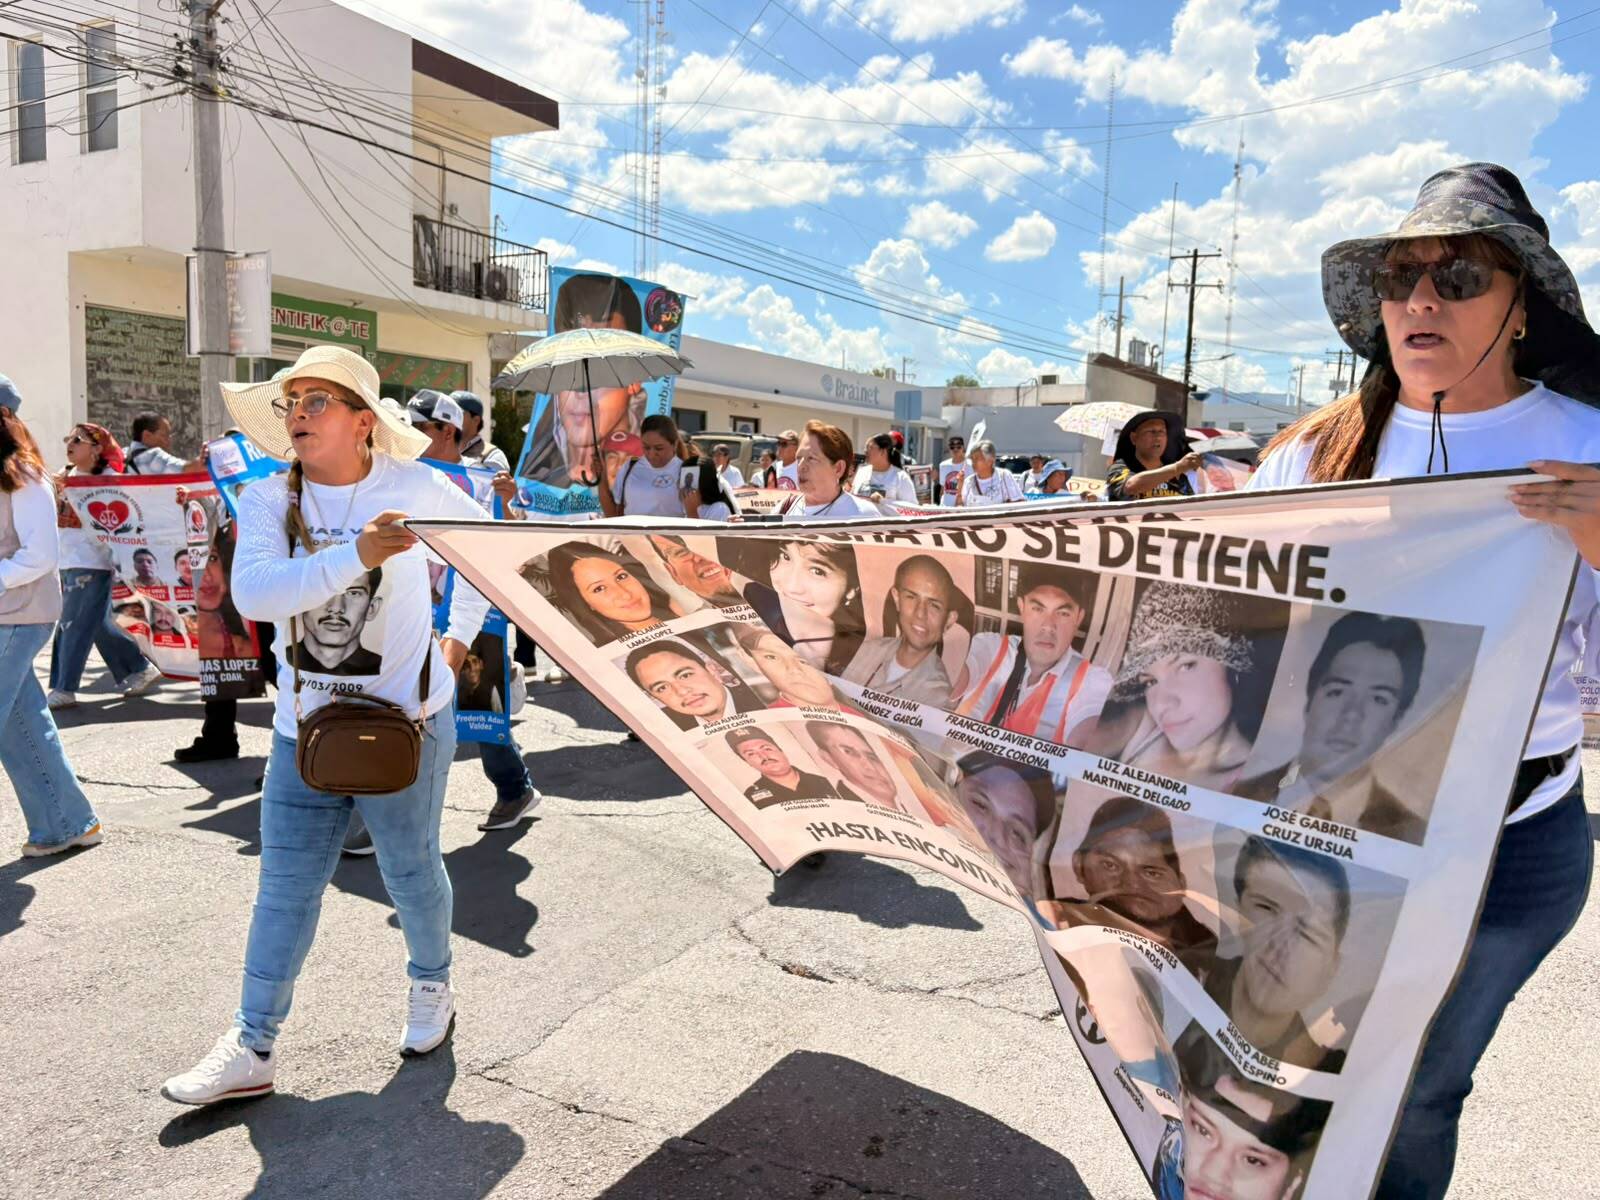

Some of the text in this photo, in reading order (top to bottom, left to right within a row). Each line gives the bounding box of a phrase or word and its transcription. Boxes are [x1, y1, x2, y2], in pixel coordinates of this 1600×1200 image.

[835, 377, 880, 405] Brainet
[1022, 525, 1082, 564] SE
[1098, 523, 1347, 604] DETIENE.
[223, 659, 259, 671] LOPEZ
[861, 688, 900, 708] ROBERTO
[893, 713, 923, 729] GARCÍA
[945, 714, 1000, 739] FRANCISCO
[999, 726, 1037, 750] JAVIER
[1033, 742, 1069, 759] OSIRIS
[946, 728, 1005, 757] HERNANDEZ
[1005, 748, 1051, 770] CORONA
[1082, 769, 1191, 812] MARTINEZ DELGADO
[1097, 758, 1188, 796] LUZ ALEJANDRA
[1262, 805, 1359, 843] JOSÉ GABRIEL
[1262, 823, 1353, 860] CRUZ URSUA
[1102, 927, 1178, 969] ANTONIO TORRES
[1119, 936, 1164, 973] DE LA ROSA
[421, 985, 437, 993] FILA
[1215, 1028, 1287, 1086] MIRELES ESPINO
[1226, 1021, 1281, 1072] SERGIO ABEL
